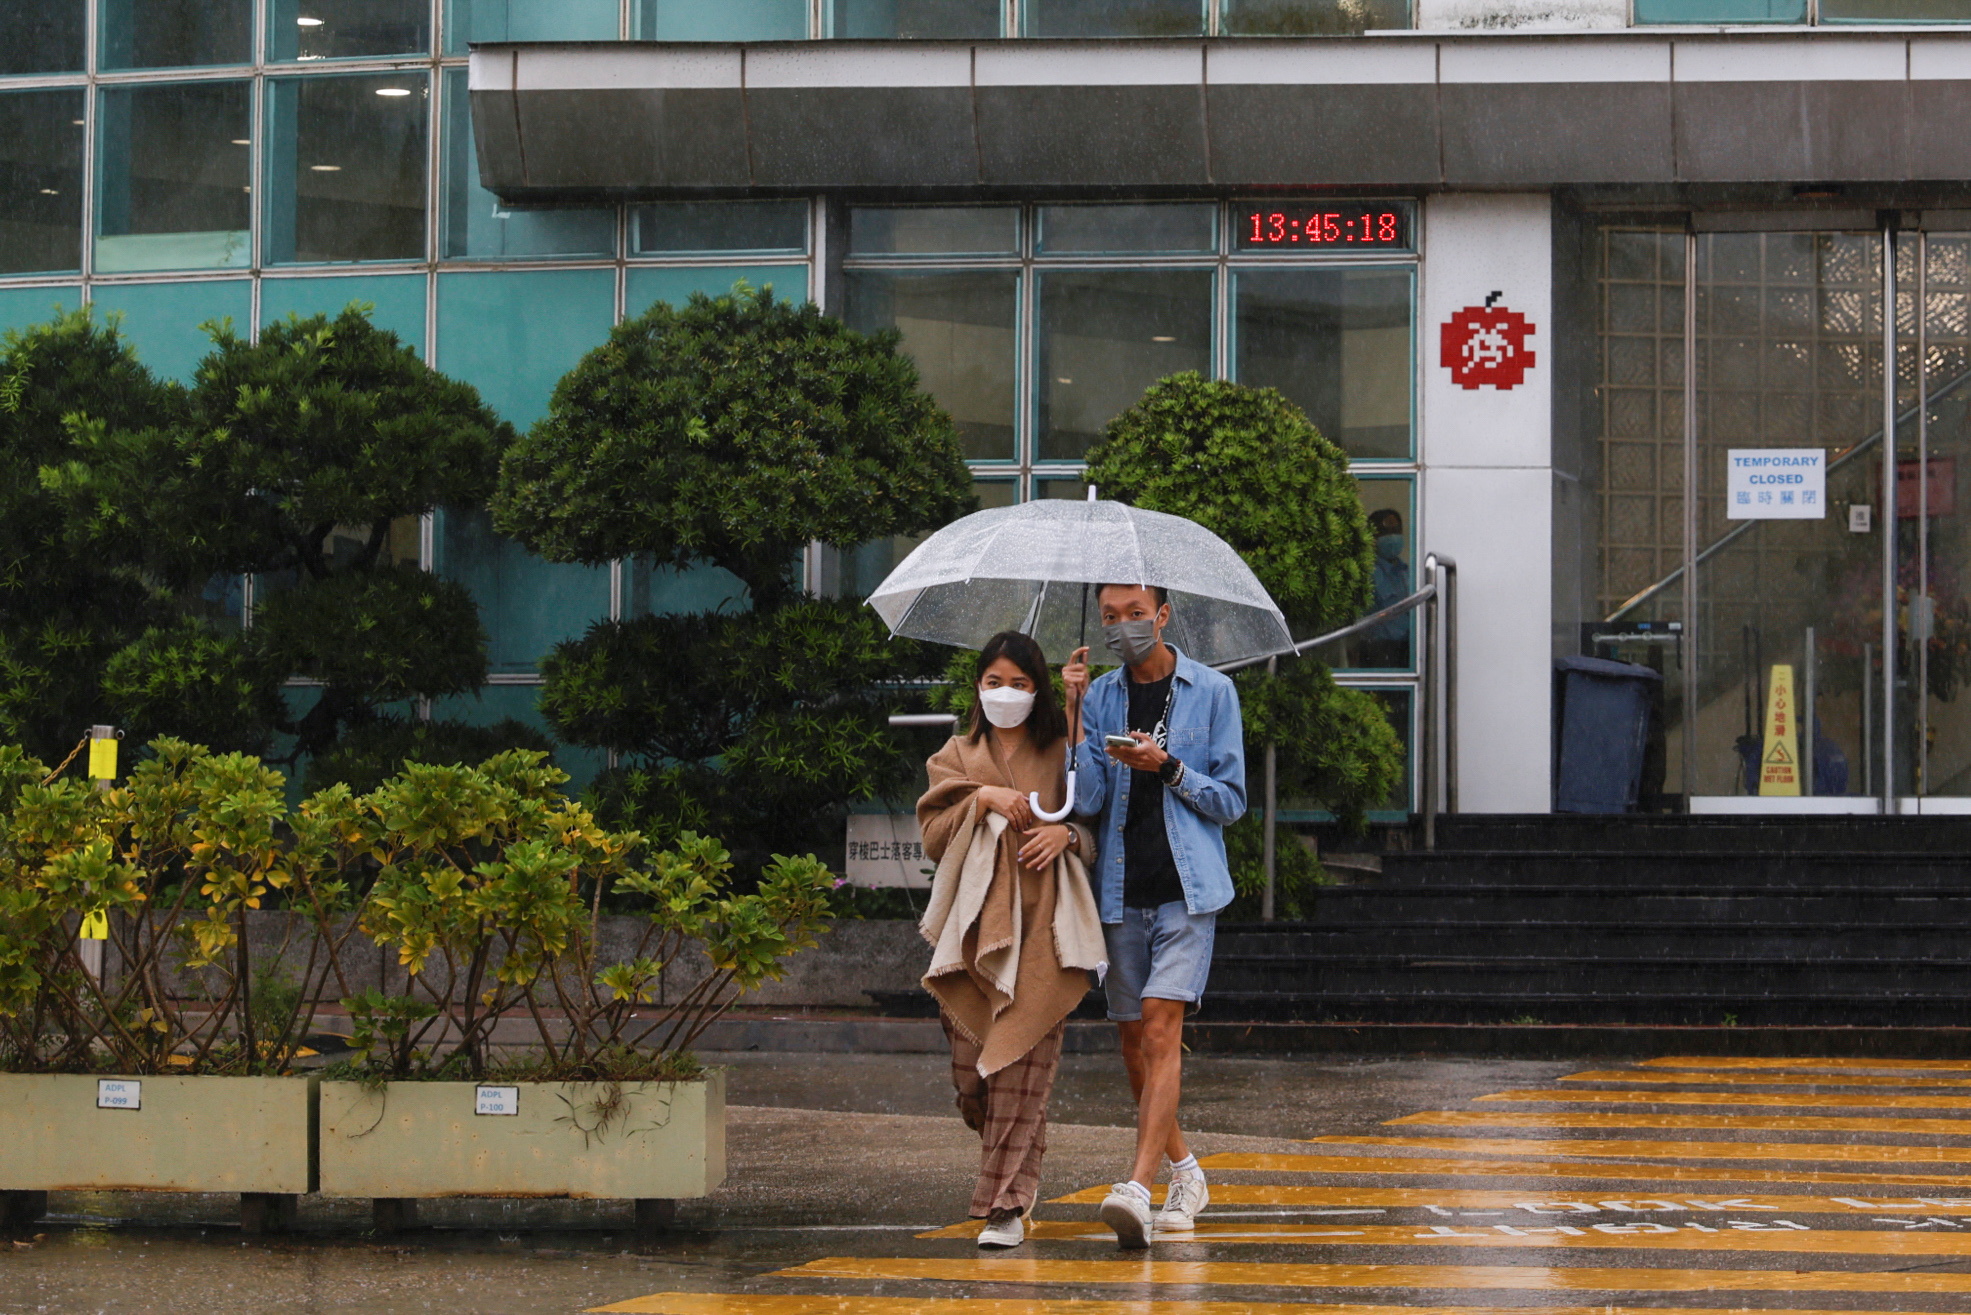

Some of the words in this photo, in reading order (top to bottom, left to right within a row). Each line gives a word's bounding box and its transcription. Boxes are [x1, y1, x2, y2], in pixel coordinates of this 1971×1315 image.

[1250, 213, 1397, 242] 13:45:18
[1734, 456, 1819, 467] TEMPORARY
[1749, 474, 1804, 484] CLOSED
[1736, 490, 1817, 505] 臨時關閉
[1774, 684, 1787, 737] 小心地滑
[1766, 766, 1792, 774] CAUTION
[1764, 775, 1775, 783] WET
[1777, 775, 1794, 783] FLOOR
[848, 841, 929, 861] 穿梭巴士落客專
[105, 1084, 126, 1092] ADPL
[481, 1090, 502, 1098] ADPL
[104, 1096, 127, 1105] P-099
[480, 1103, 504, 1111] P-100
[1421, 1198, 1779, 1216] LOOK
